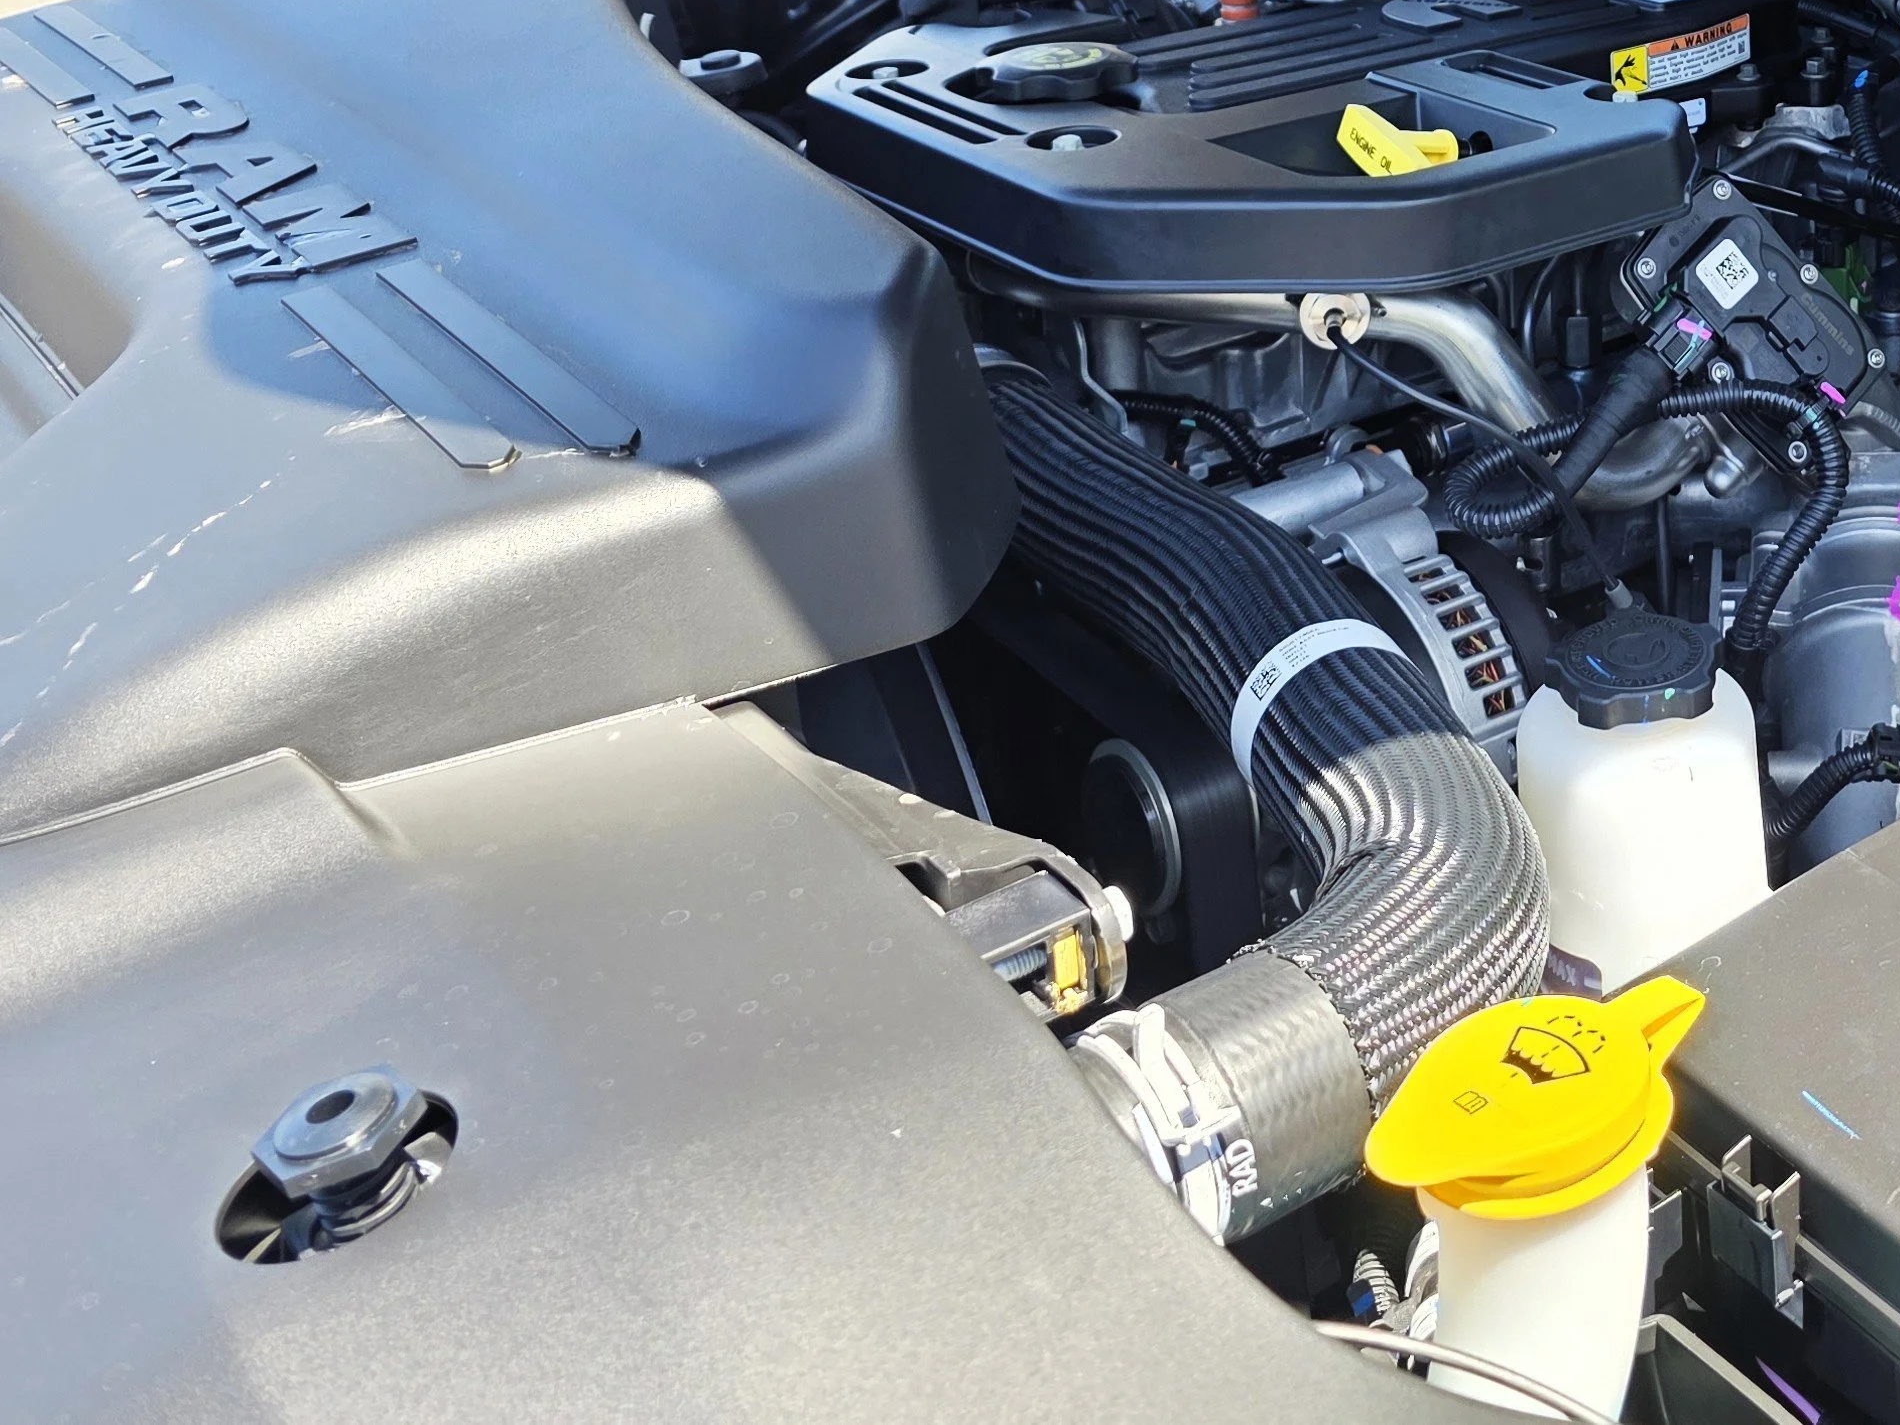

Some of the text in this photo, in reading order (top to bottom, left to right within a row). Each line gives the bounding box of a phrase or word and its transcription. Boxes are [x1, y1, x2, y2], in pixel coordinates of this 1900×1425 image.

[1684, 22, 1733, 47] WARNING
[113, 84, 418, 274] RAM
[1350, 127, 1393, 175] ENGINE OIL
[52, 106, 310, 286] HEAVY DUTY
[1802, 292, 1855, 356] Cummins
[1548, 952, 1577, 987] MAX
[1224, 1138, 1258, 1198] RAD
